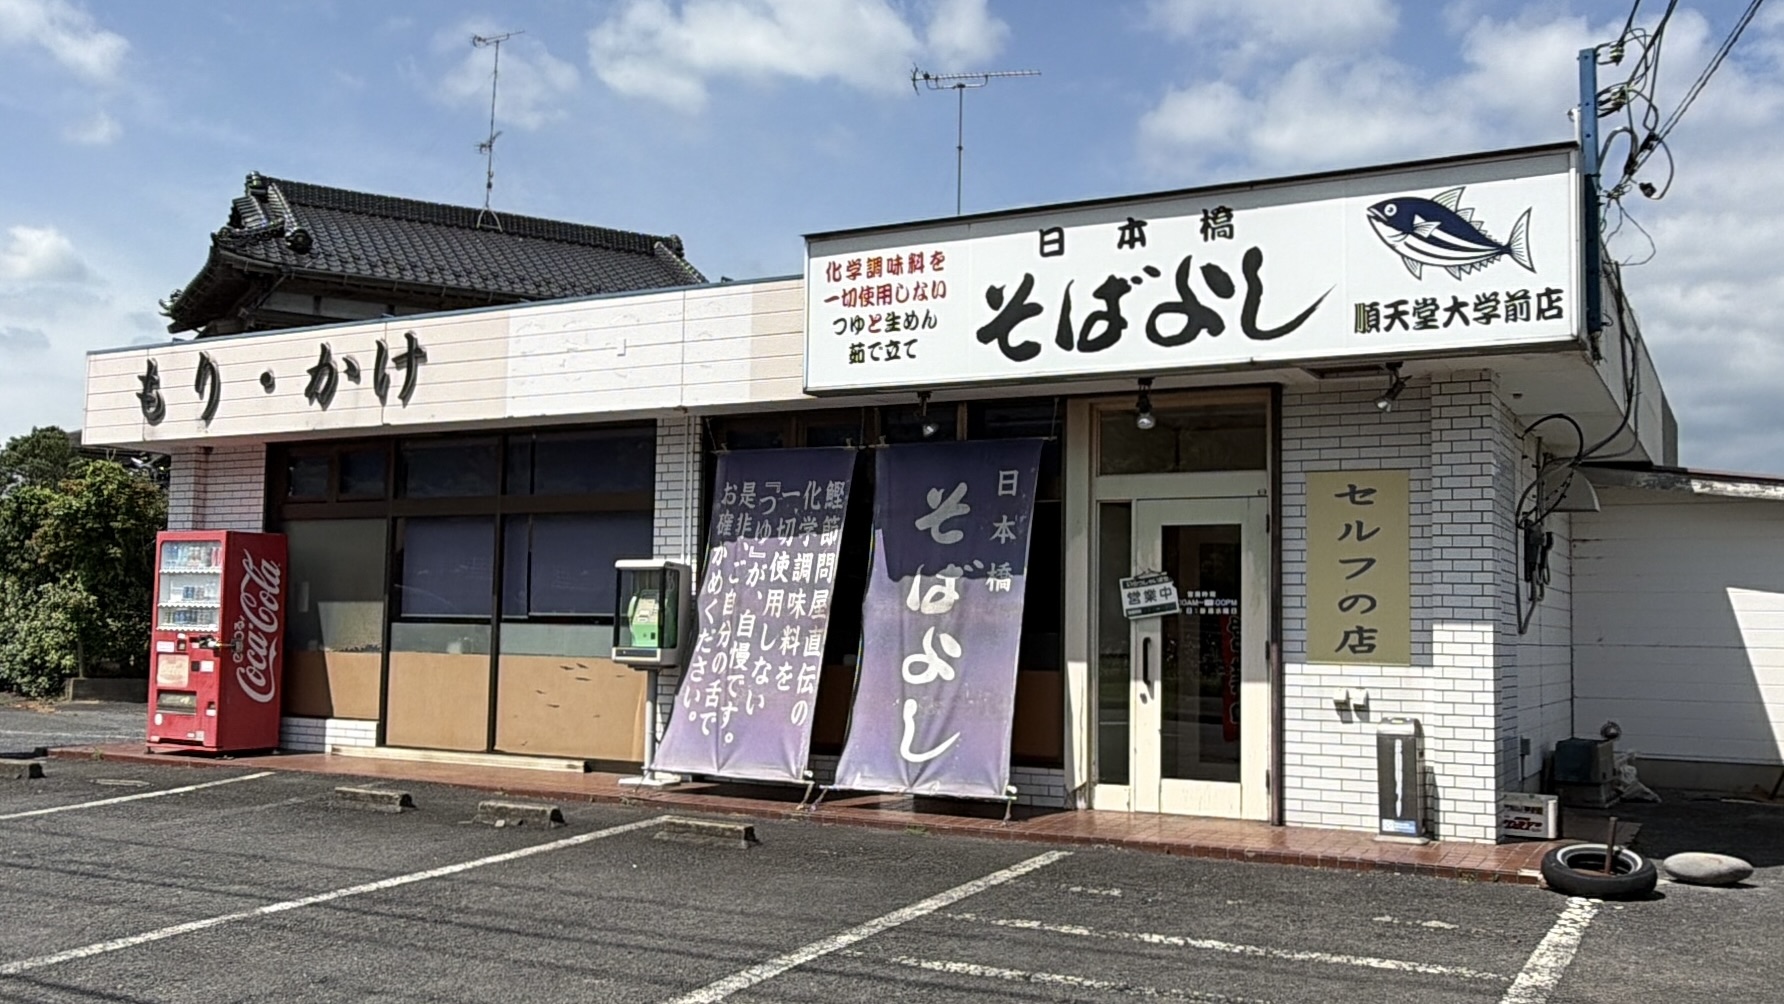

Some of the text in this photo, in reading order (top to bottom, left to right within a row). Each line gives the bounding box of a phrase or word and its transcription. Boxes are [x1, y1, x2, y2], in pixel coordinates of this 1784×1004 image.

[826, 249, 946, 283] 化学調味料を
[1038, 205, 1235, 258] 日本橋
[823, 279, 947, 308] 一切使用しない
[832, 308, 938, 336] つゆと生めん
[976, 246, 1337, 362] そばよし
[1353, 287, 1564, 335] 順天堂大学前店
[135, 329, 428, 428] もり・かけ
[848, 338, 919, 365] 茹で立て
[984, 469, 1019, 593] 日本橋
[775, 479, 822, 692] 化学調味料を
[790, 479, 847, 727] 鰹節問屋直伝の
[1127, 586, 1173, 606] 営業中
[1334, 484, 1381, 655] セルフの店
[900, 482, 984, 763] そばよし
